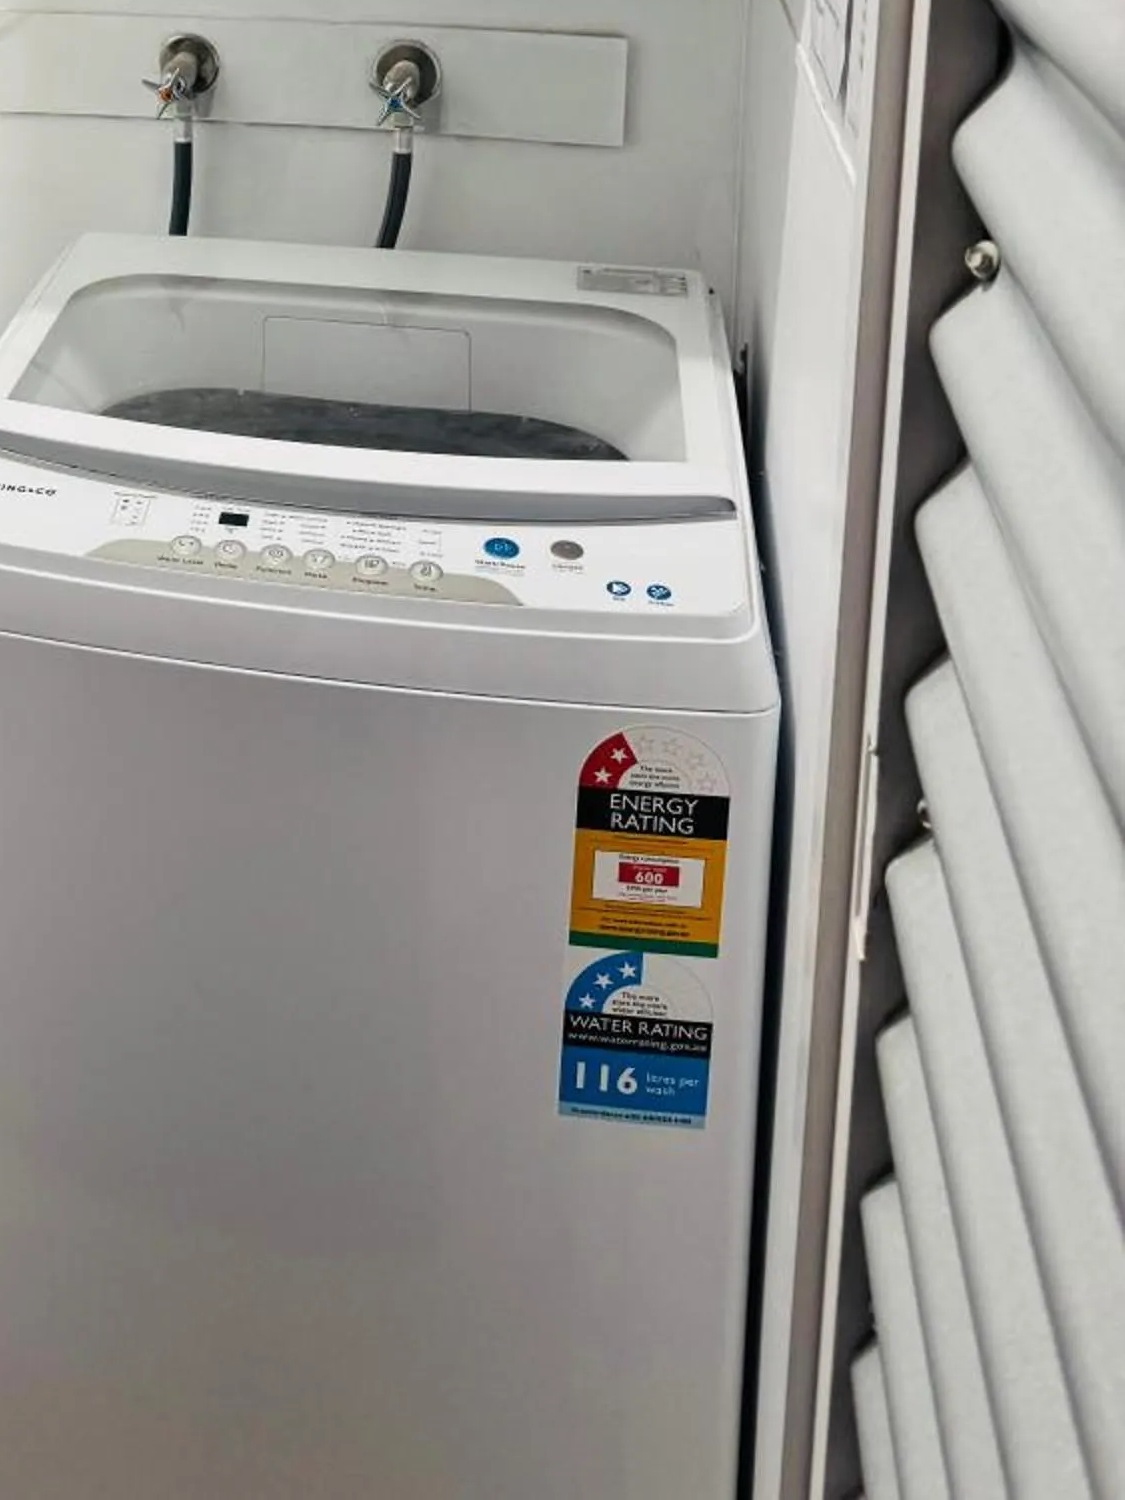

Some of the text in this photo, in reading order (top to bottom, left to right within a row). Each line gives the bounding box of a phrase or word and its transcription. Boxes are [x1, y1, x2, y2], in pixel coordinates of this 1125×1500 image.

[610, 793, 699, 815] ENERGY
[610, 812, 695, 835] RATING
[635, 871, 664, 885] 600
[570, 1014, 708, 1041] WATER RATING
[576, 1061, 637, 1095] 116
